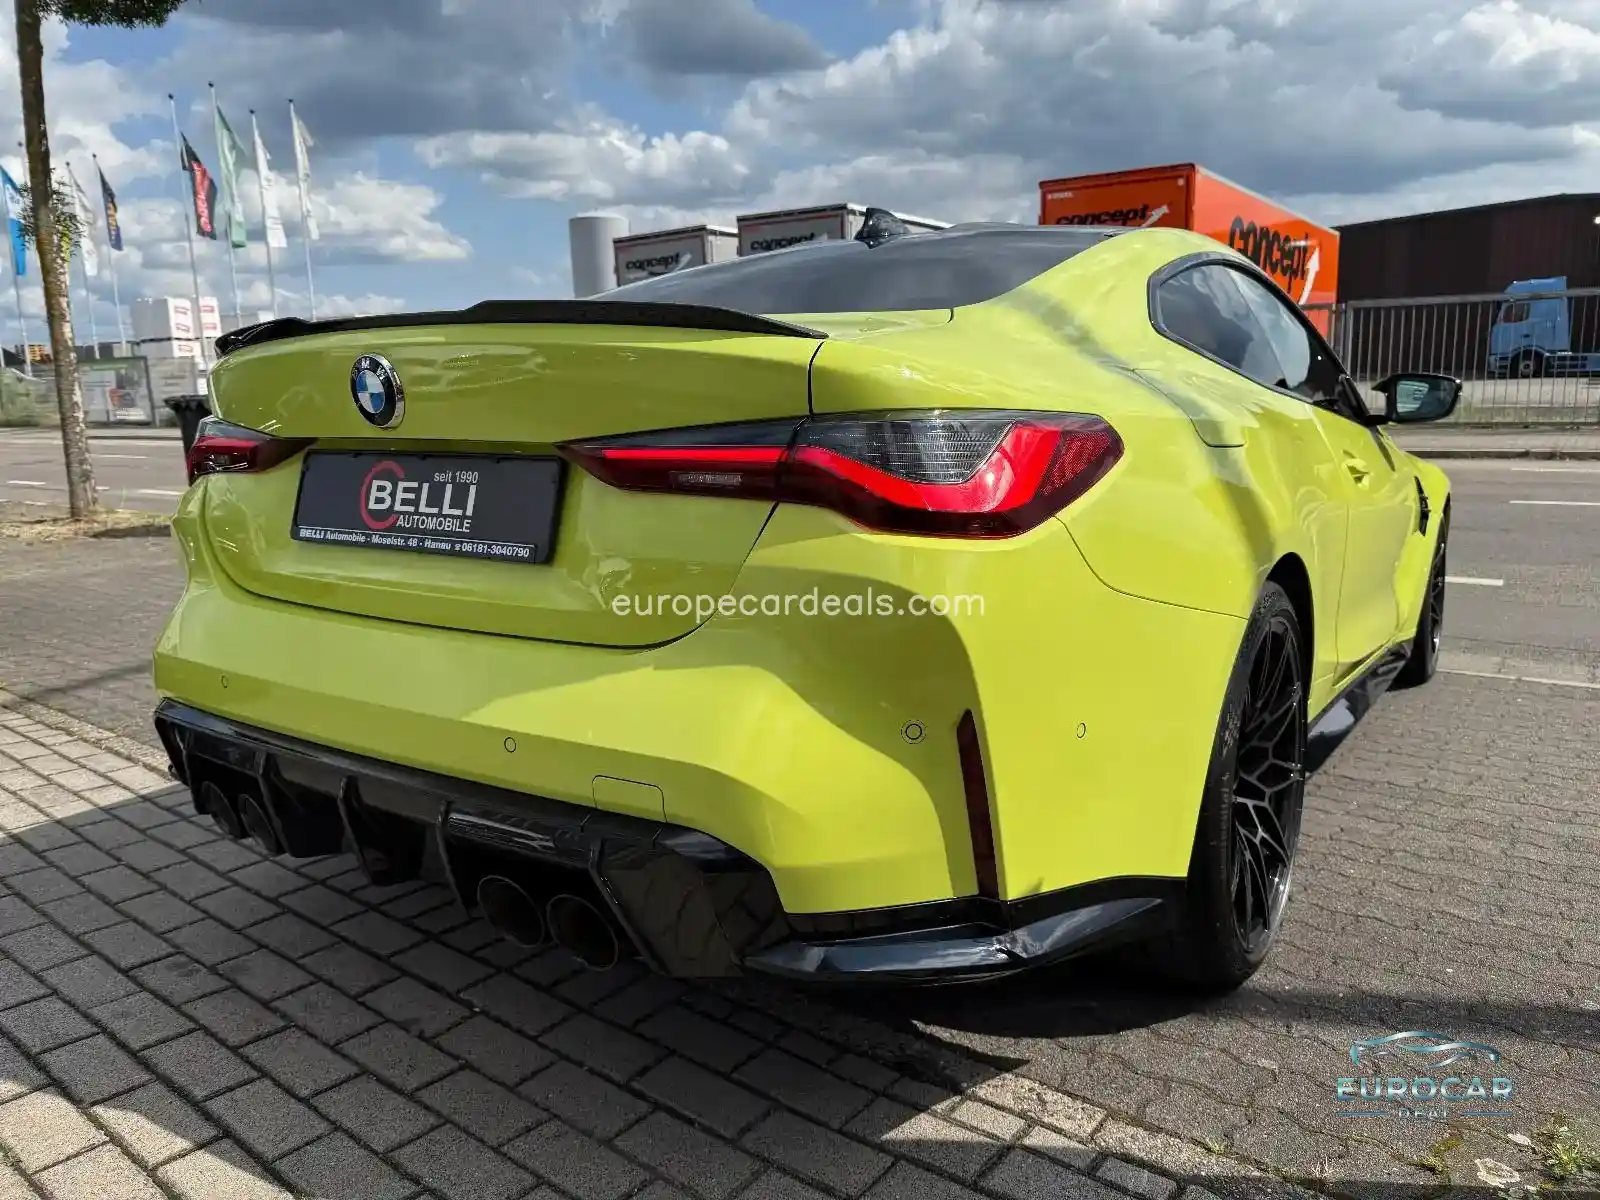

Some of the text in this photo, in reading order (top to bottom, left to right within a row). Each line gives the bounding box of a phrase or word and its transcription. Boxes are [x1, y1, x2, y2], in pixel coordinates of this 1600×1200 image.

[625, 252, 680, 271] concept
[1229, 214, 1309, 294] concept
[433, 470, 479, 484] seit 1990
[367, 479, 477, 517] BELLI
[396, 514, 472, 533] AUTOMOBILE
[299, 528, 325, 539] BELLI
[325, 530, 366, 543] Automobile
[371, 534, 406, 546] Moselstr.
[424, 538, 452, 550] Hanau
[461, 542, 530, 558] 06181-3040790
